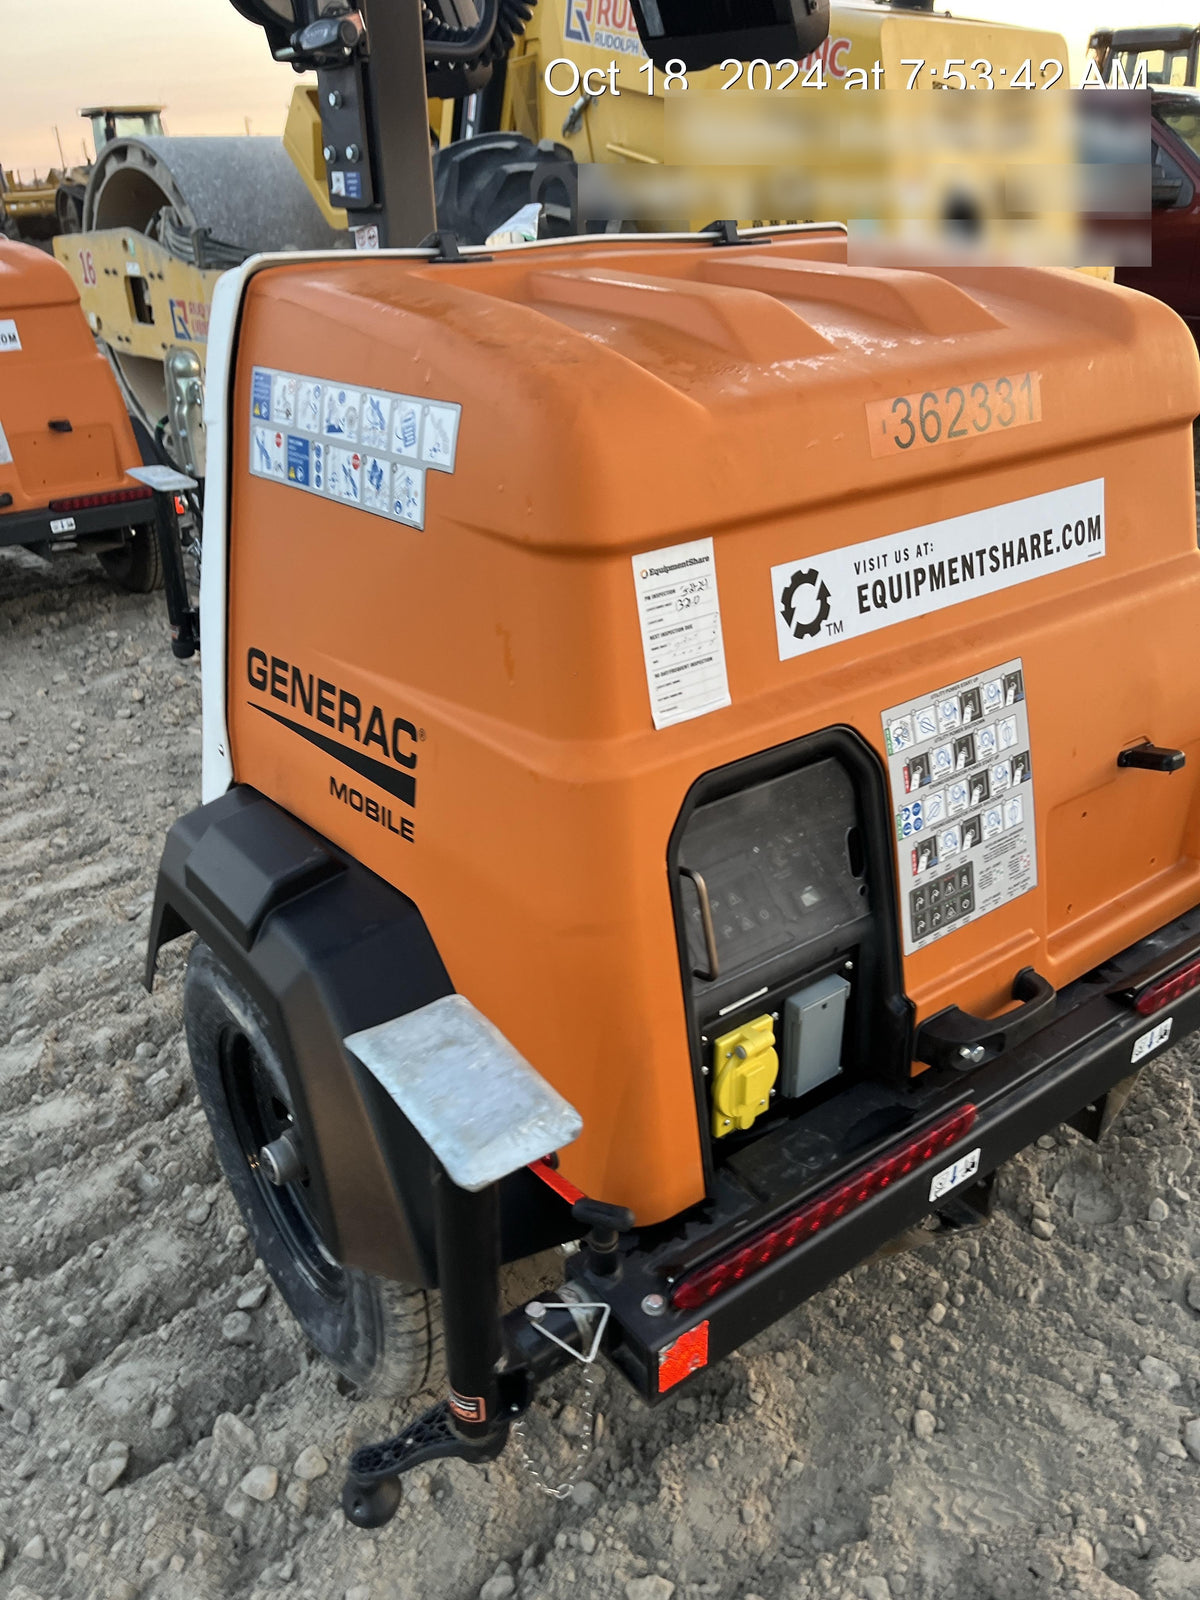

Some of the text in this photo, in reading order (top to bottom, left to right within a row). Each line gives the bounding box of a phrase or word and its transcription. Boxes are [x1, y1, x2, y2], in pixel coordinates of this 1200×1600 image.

[594, 31, 640, 54] RUDOLPH
[79, 250, 97, 285] 16
[649, 556, 710, 577] EquipmentShare
[853, 541, 935, 576] VISIT US AT:
[856, 513, 1102, 615] EQUIPMENTSHARE.COM
[247, 647, 418, 770] GENERAC
[329, 775, 416, 844] MOBILE
